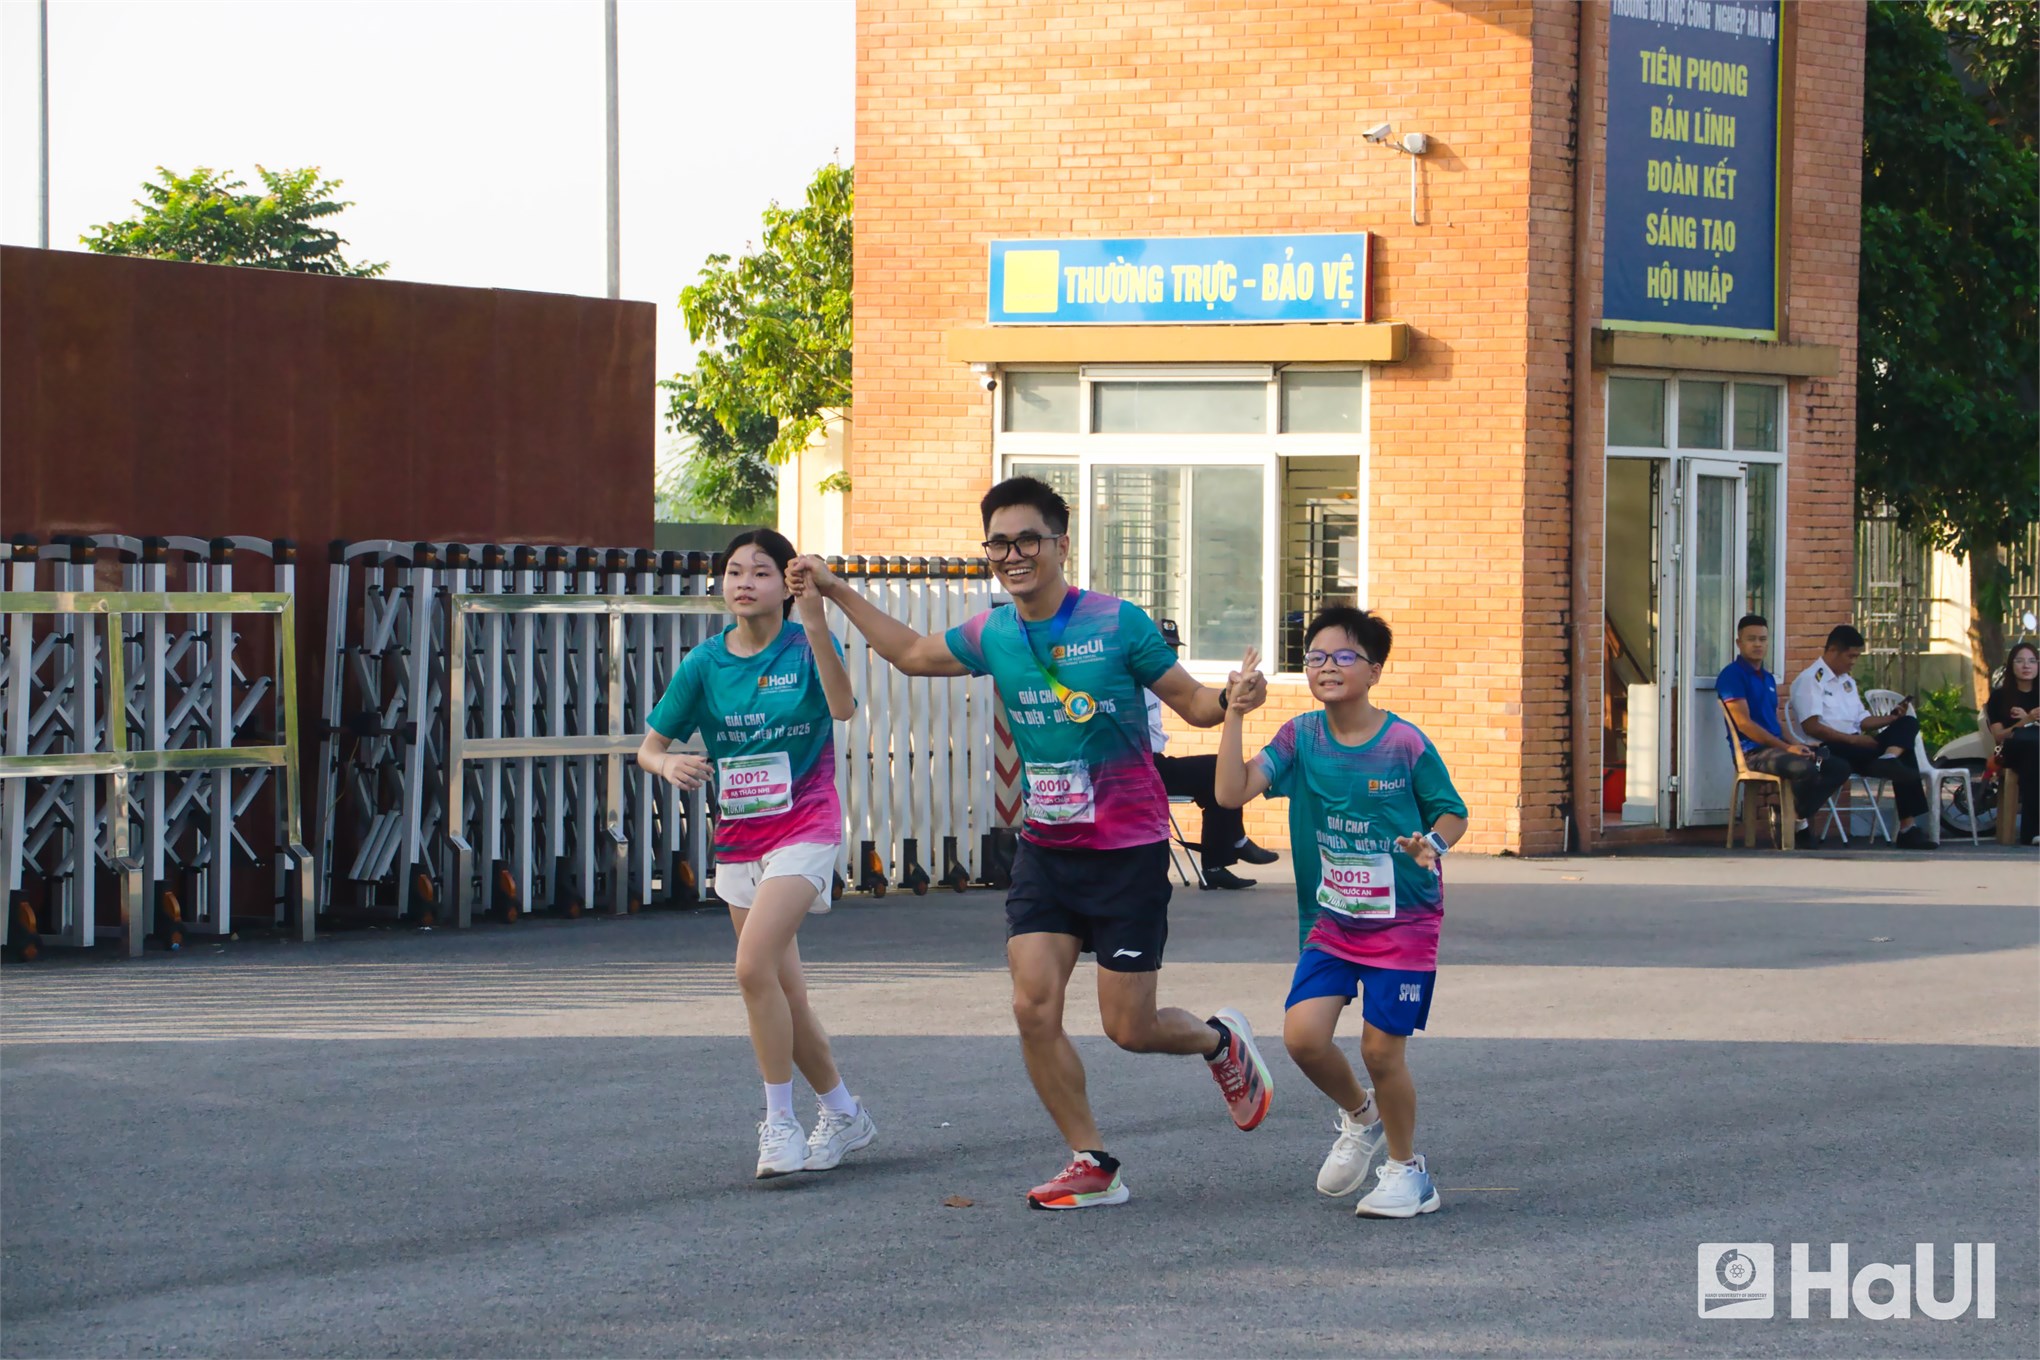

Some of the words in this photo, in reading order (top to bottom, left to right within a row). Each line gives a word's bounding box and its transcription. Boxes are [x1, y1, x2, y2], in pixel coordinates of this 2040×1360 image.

[1667, 0, 1685, 30] HỌC
[1715, 2, 1746, 40] NGHIỆP
[1748, 5, 1759, 37] HÀ
[1761, 7, 1776, 45] NỘI
[1640, 47, 1681, 87] TIÊN
[1687, 57, 1748, 97] PHONG
[1651, 95, 1689, 142] BẢN
[1694, 107, 1736, 148] LĨNH
[1647, 155, 1698, 196] ĐOÀN
[1703, 157, 1737, 200] KẾT
[1646, 208, 1697, 249] SÁNG
[1702, 218, 1736, 258] TẠO
[1064, 256, 1163, 304] THƯỜNG
[1171, 260, 1237, 310] TRỰC
[1243, 279, 1256, 287] -
[1262, 247, 1314, 302] BẢO
[1322, 253, 1355, 308] VỆ
[1647, 261, 1678, 306] HỘI
[1684, 265, 1733, 310] NHẬP
[1067, 639, 1104, 657] HaUI
[769, 673, 797, 687] HaUI
[1018, 687, 1039, 705] GIẢI
[1039, 689, 1060, 707] CHẠ
[725, 712, 743, 727] GIẢI
[744, 713, 766, 728] CHẠY
[786, 723, 811, 737] 2025
[728, 770, 769, 785] 10012
[1380, 778, 1406, 790] HaUI
[1345, 820, 1370, 837] CHẠY
[1330, 868, 1370, 884] 10013
